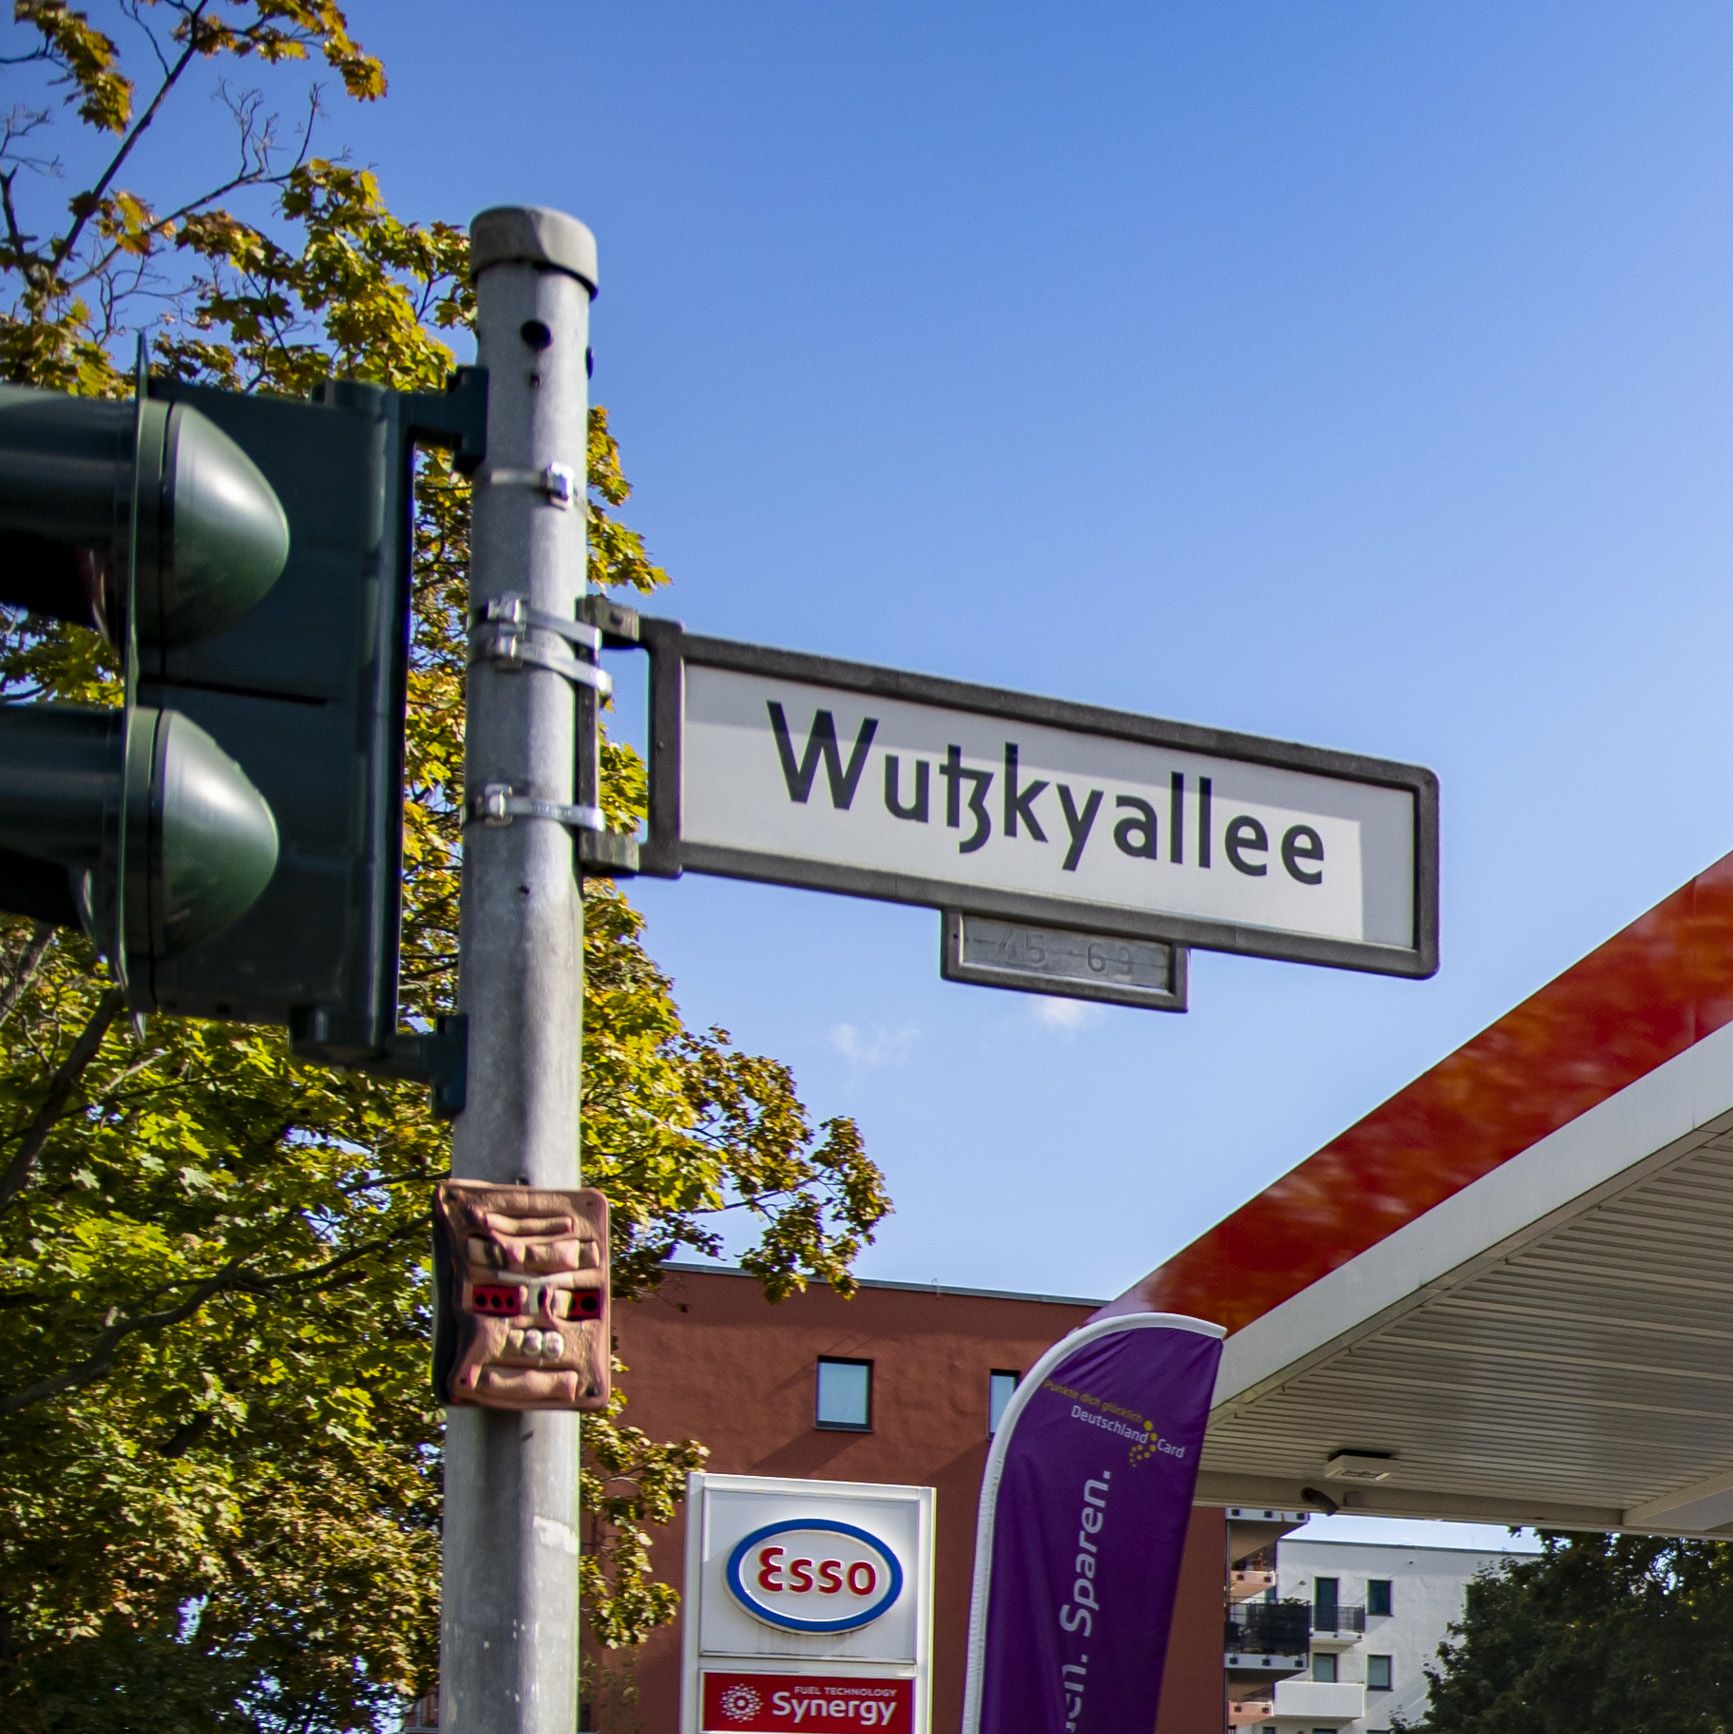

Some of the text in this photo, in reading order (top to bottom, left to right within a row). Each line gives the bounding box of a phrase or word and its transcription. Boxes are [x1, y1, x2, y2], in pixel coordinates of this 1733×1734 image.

[766, 699, 1325, 886] Wutzkyallee
[1070, 1404, 1186, 1459] Deutschland Card
[756, 1546, 878, 1597] Esso
[1060, 1469, 1112, 1637] Sparen.
[772, 1691, 898, 1726] Synergy
[794, 1686, 898, 1697] FUEL TECHNOLOGY
